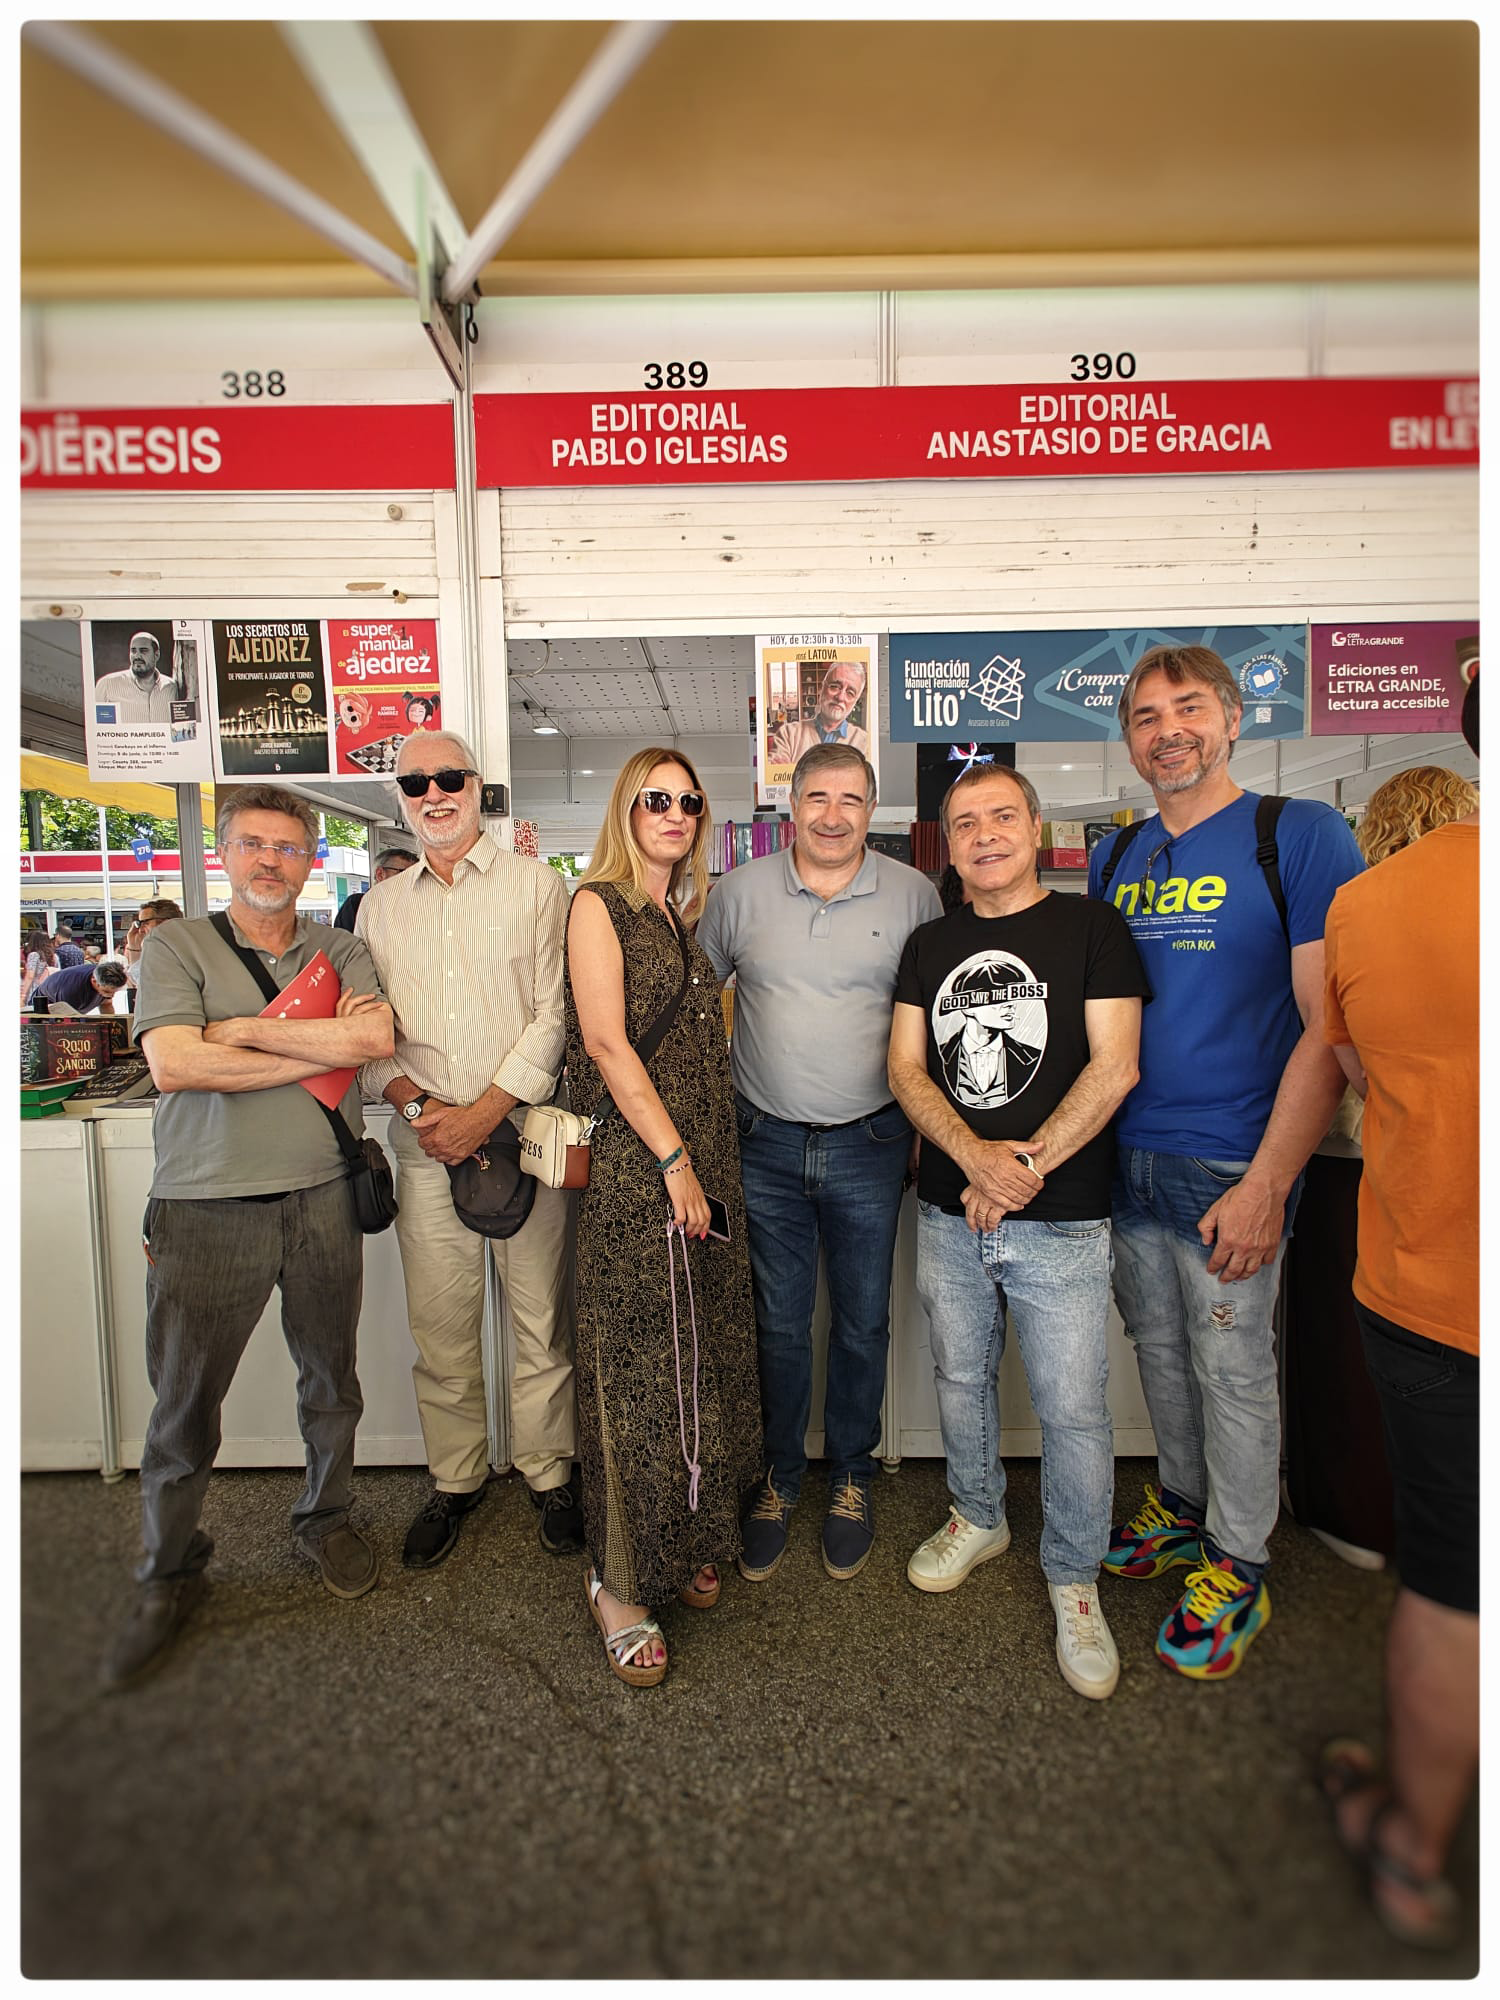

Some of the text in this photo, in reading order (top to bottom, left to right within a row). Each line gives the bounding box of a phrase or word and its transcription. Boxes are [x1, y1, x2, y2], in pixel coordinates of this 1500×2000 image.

[1070, 352, 1137, 380] 390
[643, 361, 709, 390] 389
[220, 370, 287, 399] 388
[591, 402, 747, 432] EDITORIAL
[1020, 393, 1176, 424] EDITORIAL
[927, 423, 1272, 459] ANASTASIO DE GRACIA
[552, 435, 789, 467] PABLO IGLESIAS
[226, 623, 309, 638] LOS SECRETOS DEL
[350, 624, 393, 640] super
[360, 635, 414, 651] manual
[770, 635, 788, 646] HOY,
[790, 635, 799, 645] de
[802, 635, 827, 645] 12:30h
[837, 634, 862, 645] 13:30h
[1347, 637, 1405, 647] LETRAGRANDE
[227, 637, 312, 663] AJEDREZ
[808, 649, 838, 660] LATOVA
[345, 652, 432, 681] ajedrez
[905, 659, 970, 678] Fundación
[1328, 664, 1418, 677] Ediciones en
[905, 677, 970, 689] Manuel Fernández
[1056, 668, 1129, 693] ¡Compro
[1328, 678, 1447, 694] LETRA GRANDE,
[1084, 695, 1114, 707] con
[1328, 695, 1450, 711] lectura accesible
[773, 771, 792, 782] CRÓN
[943, 984, 1044, 1010] GOD SAVE THE BOSS
[57, 1039, 91, 1056] ROJO
[56, 1057, 97, 1074] SANGRE
